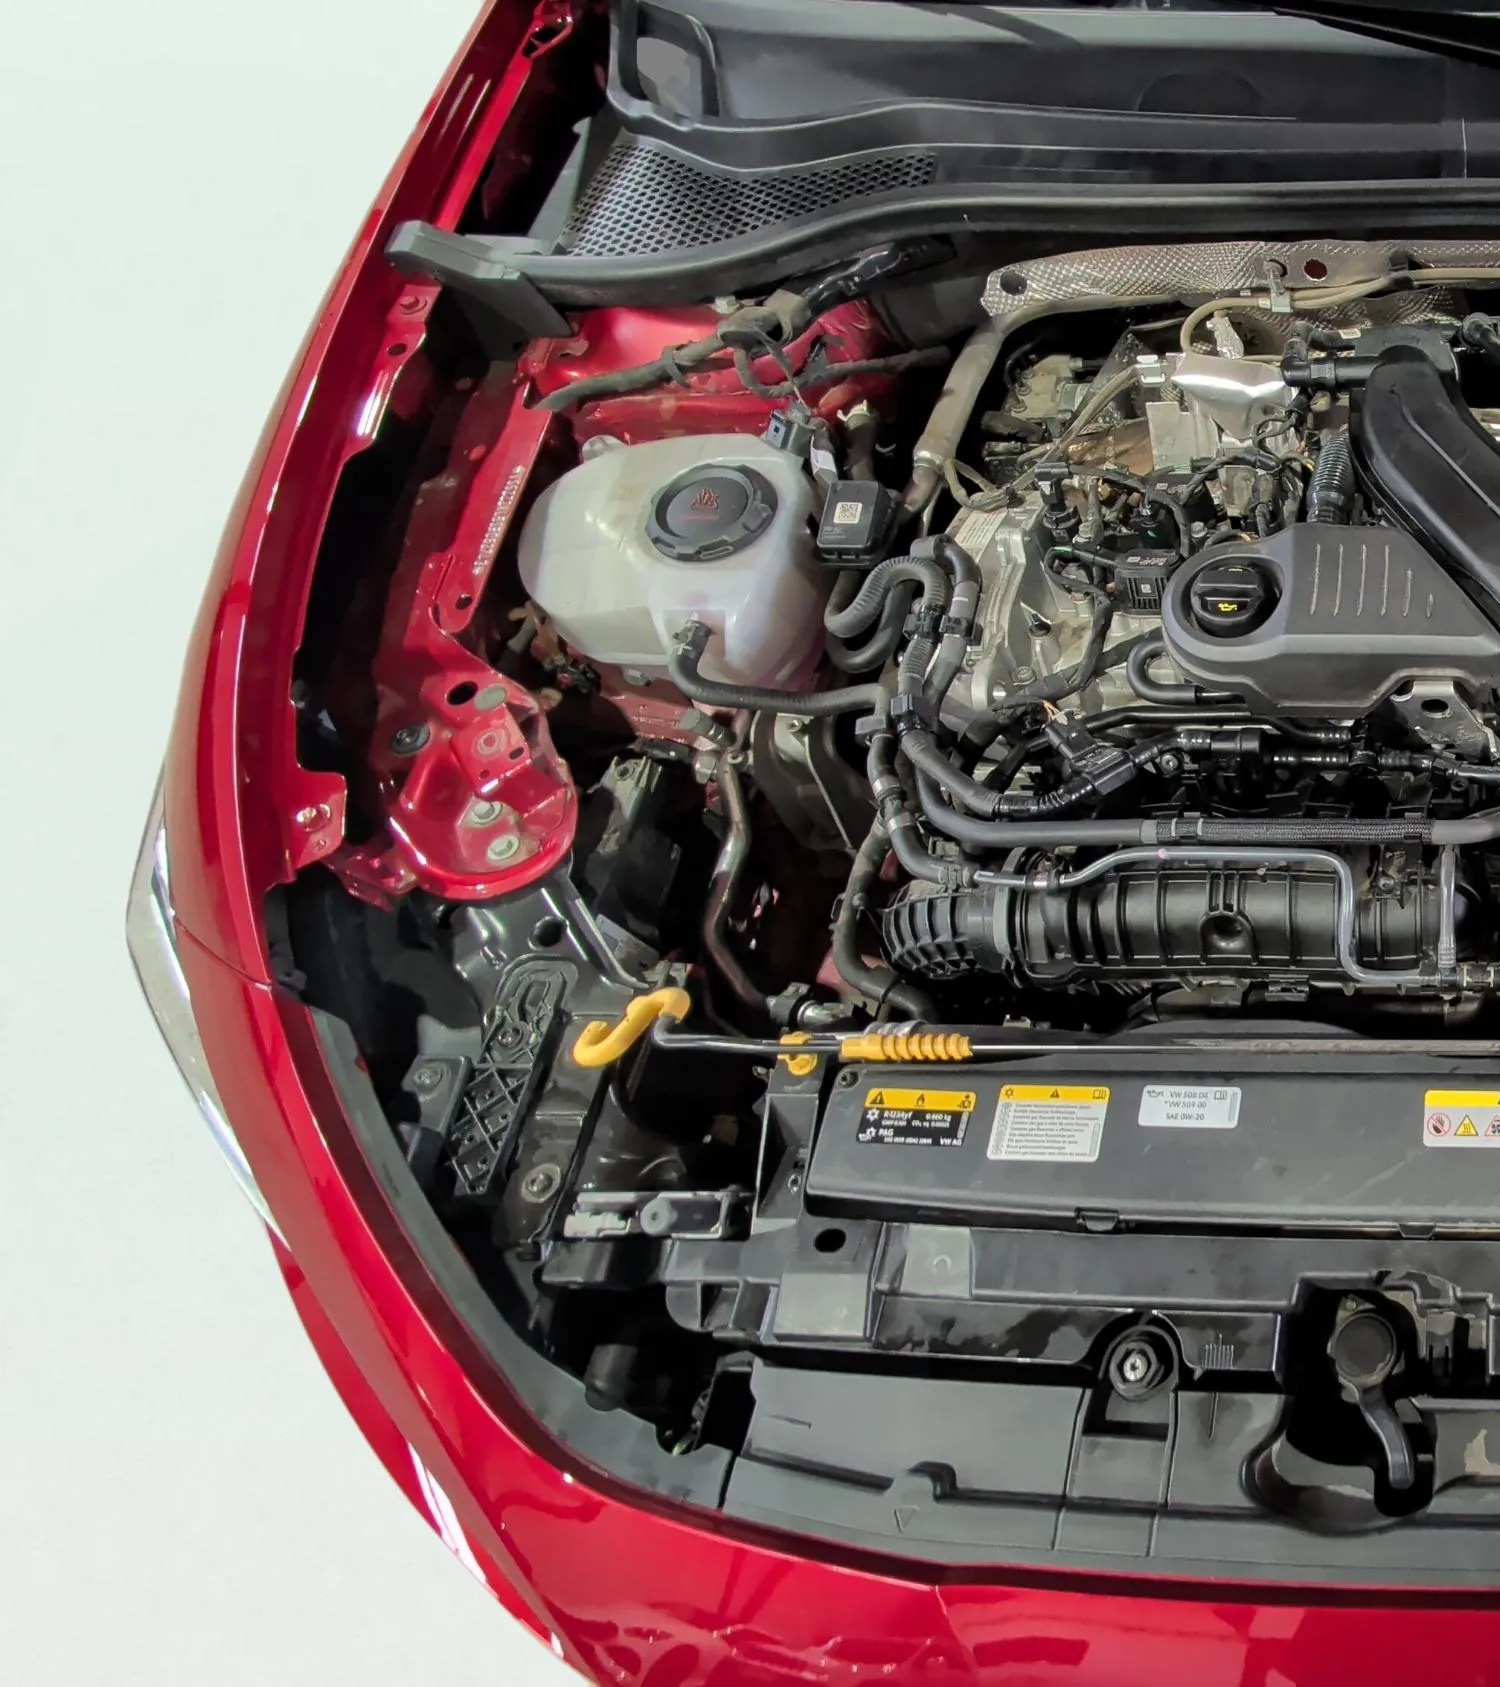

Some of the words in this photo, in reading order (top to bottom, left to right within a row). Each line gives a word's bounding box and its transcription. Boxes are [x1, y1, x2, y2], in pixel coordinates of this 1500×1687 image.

[1170, 1091, 1181, 1099] VW
[1166, 1112, 1178, 1120] SAE
[878, 1128, 895, 1137] PAG
[940, 1136, 952, 1146] VW
[952, 1138, 962, 1147] AG
